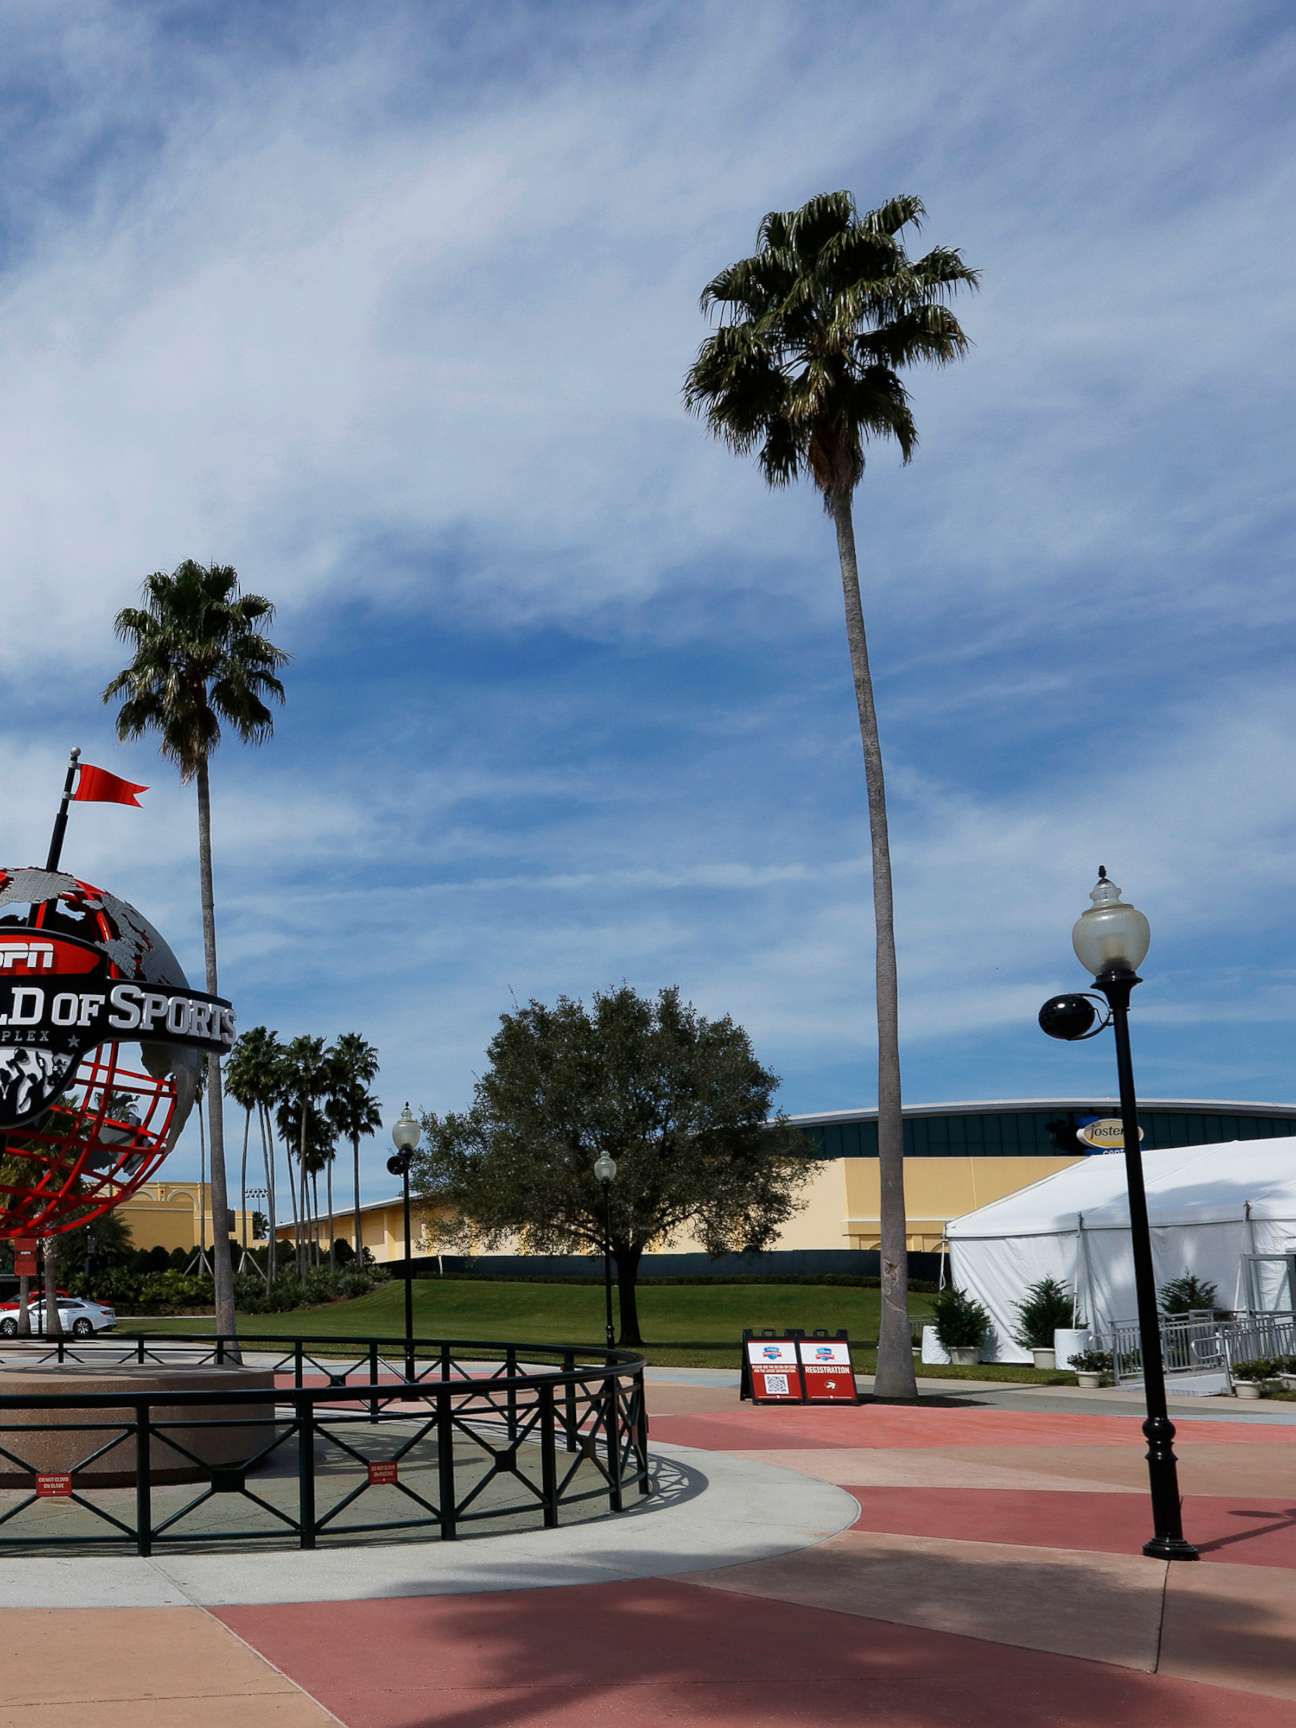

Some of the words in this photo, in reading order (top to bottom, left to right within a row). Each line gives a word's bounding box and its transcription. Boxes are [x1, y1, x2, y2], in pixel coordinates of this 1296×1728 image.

[51, 992, 106, 1027] OF
[108, 984, 237, 1045] SPORTS
[805, 1365, 851, 1374] REGISTRATION
